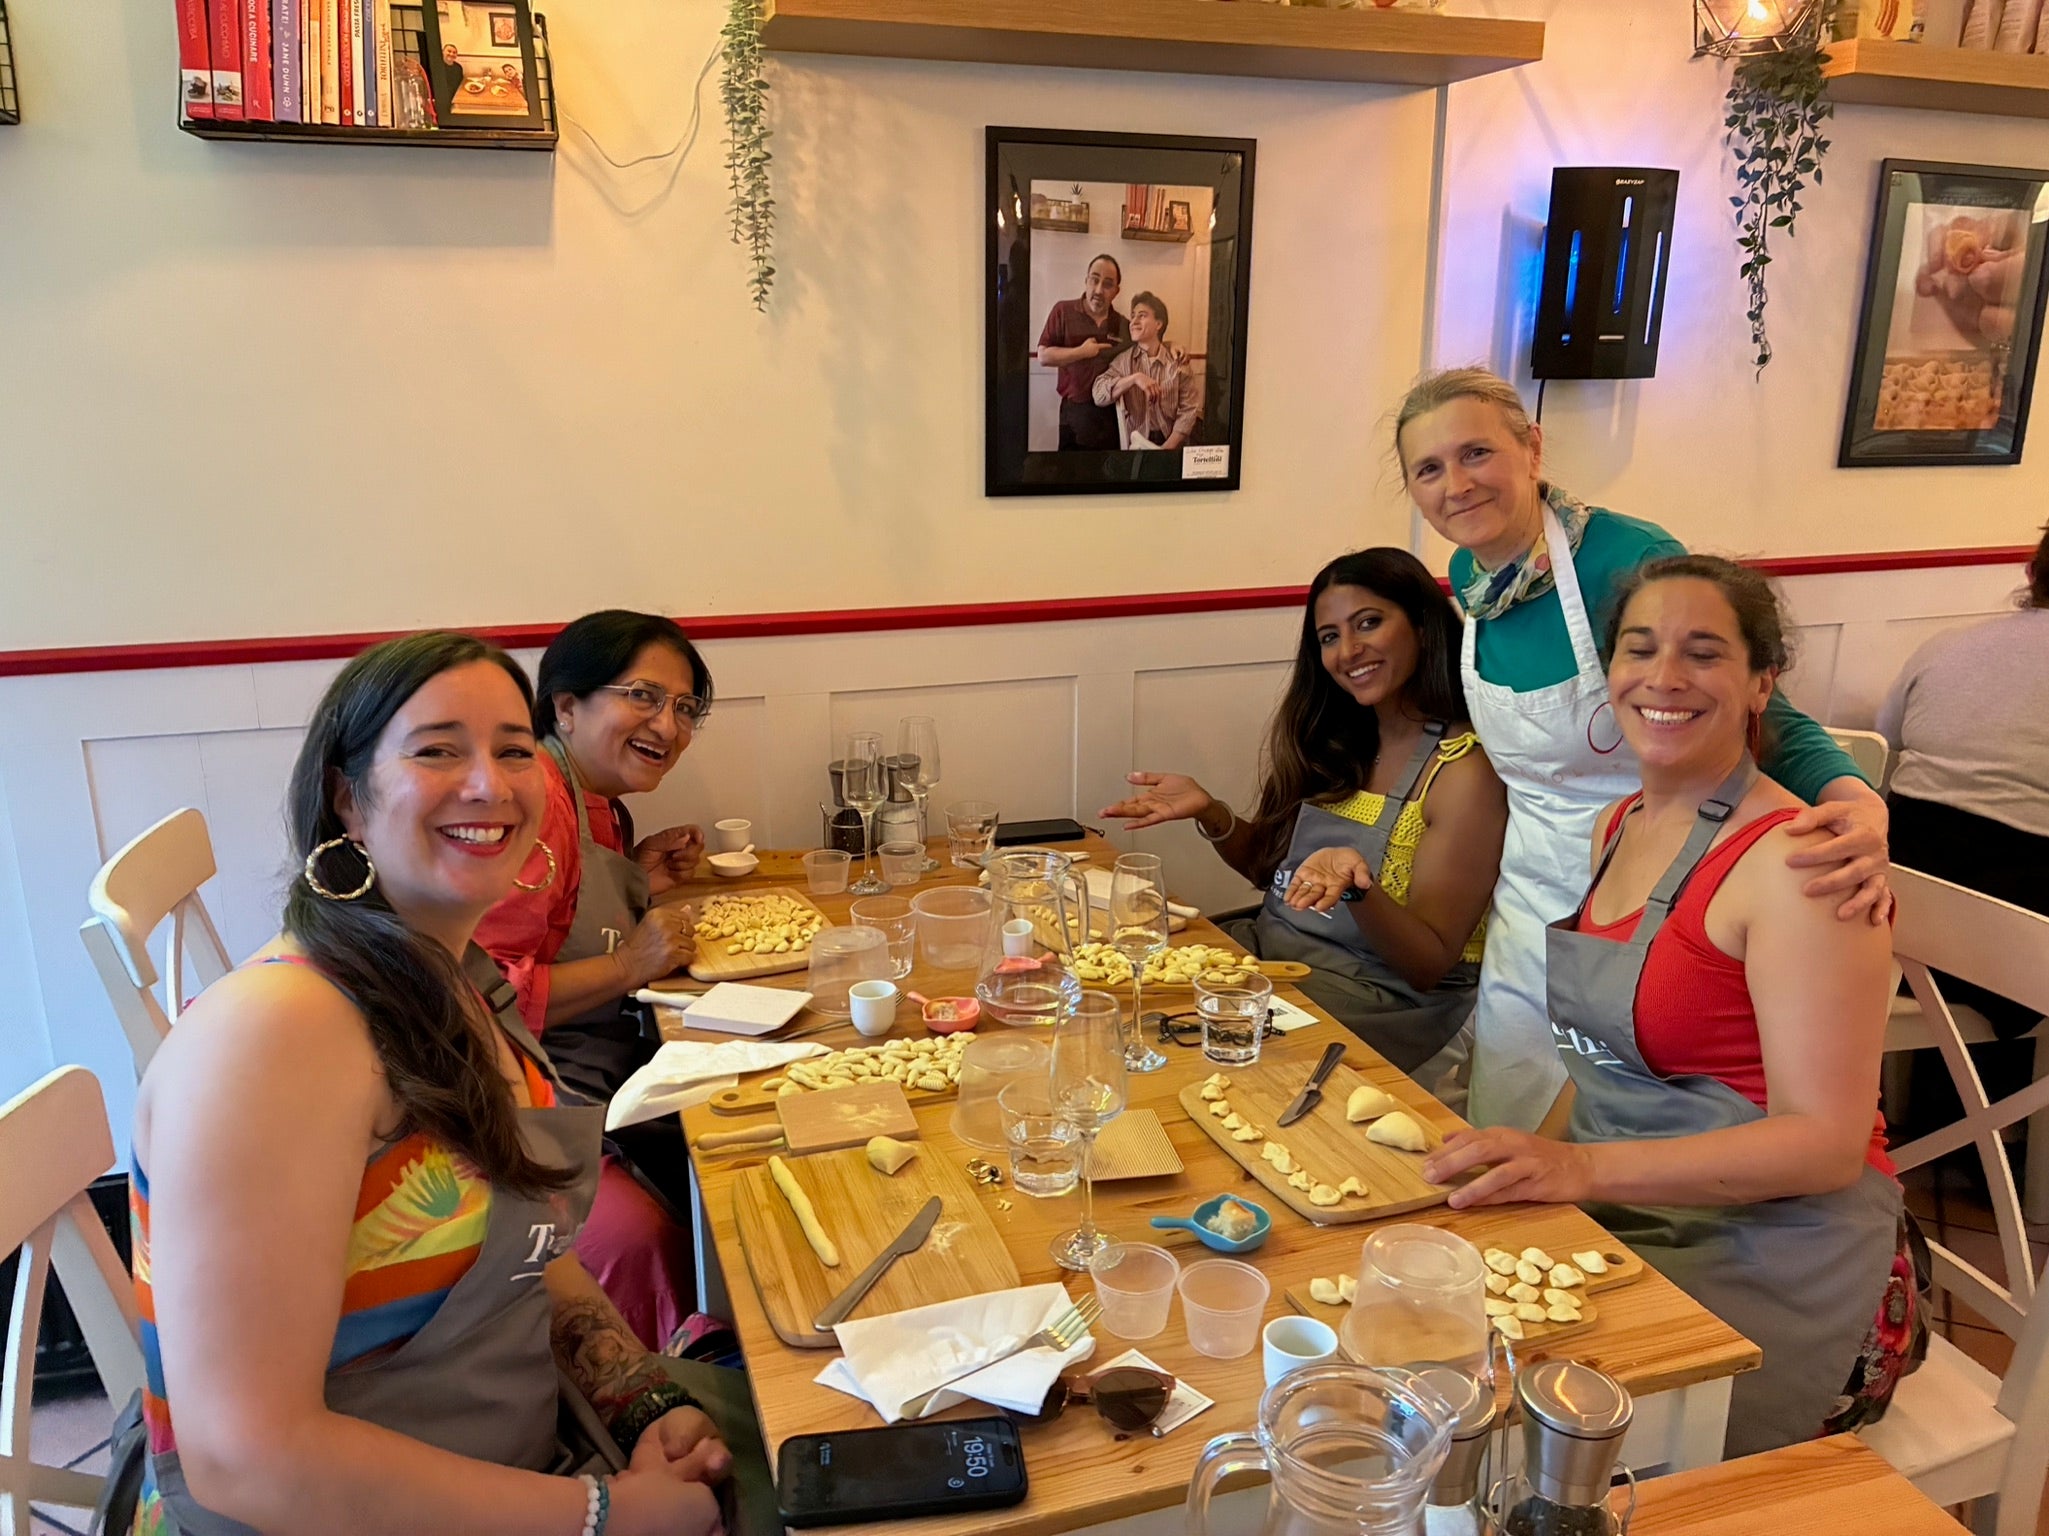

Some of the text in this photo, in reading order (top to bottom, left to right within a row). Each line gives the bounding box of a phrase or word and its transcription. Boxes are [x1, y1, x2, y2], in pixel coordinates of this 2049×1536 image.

[249, 21, 258, 62] CUCINARE
[281, 42, 290, 93] JANE DUNN
[963, 1436, 989, 1478] 19:50
